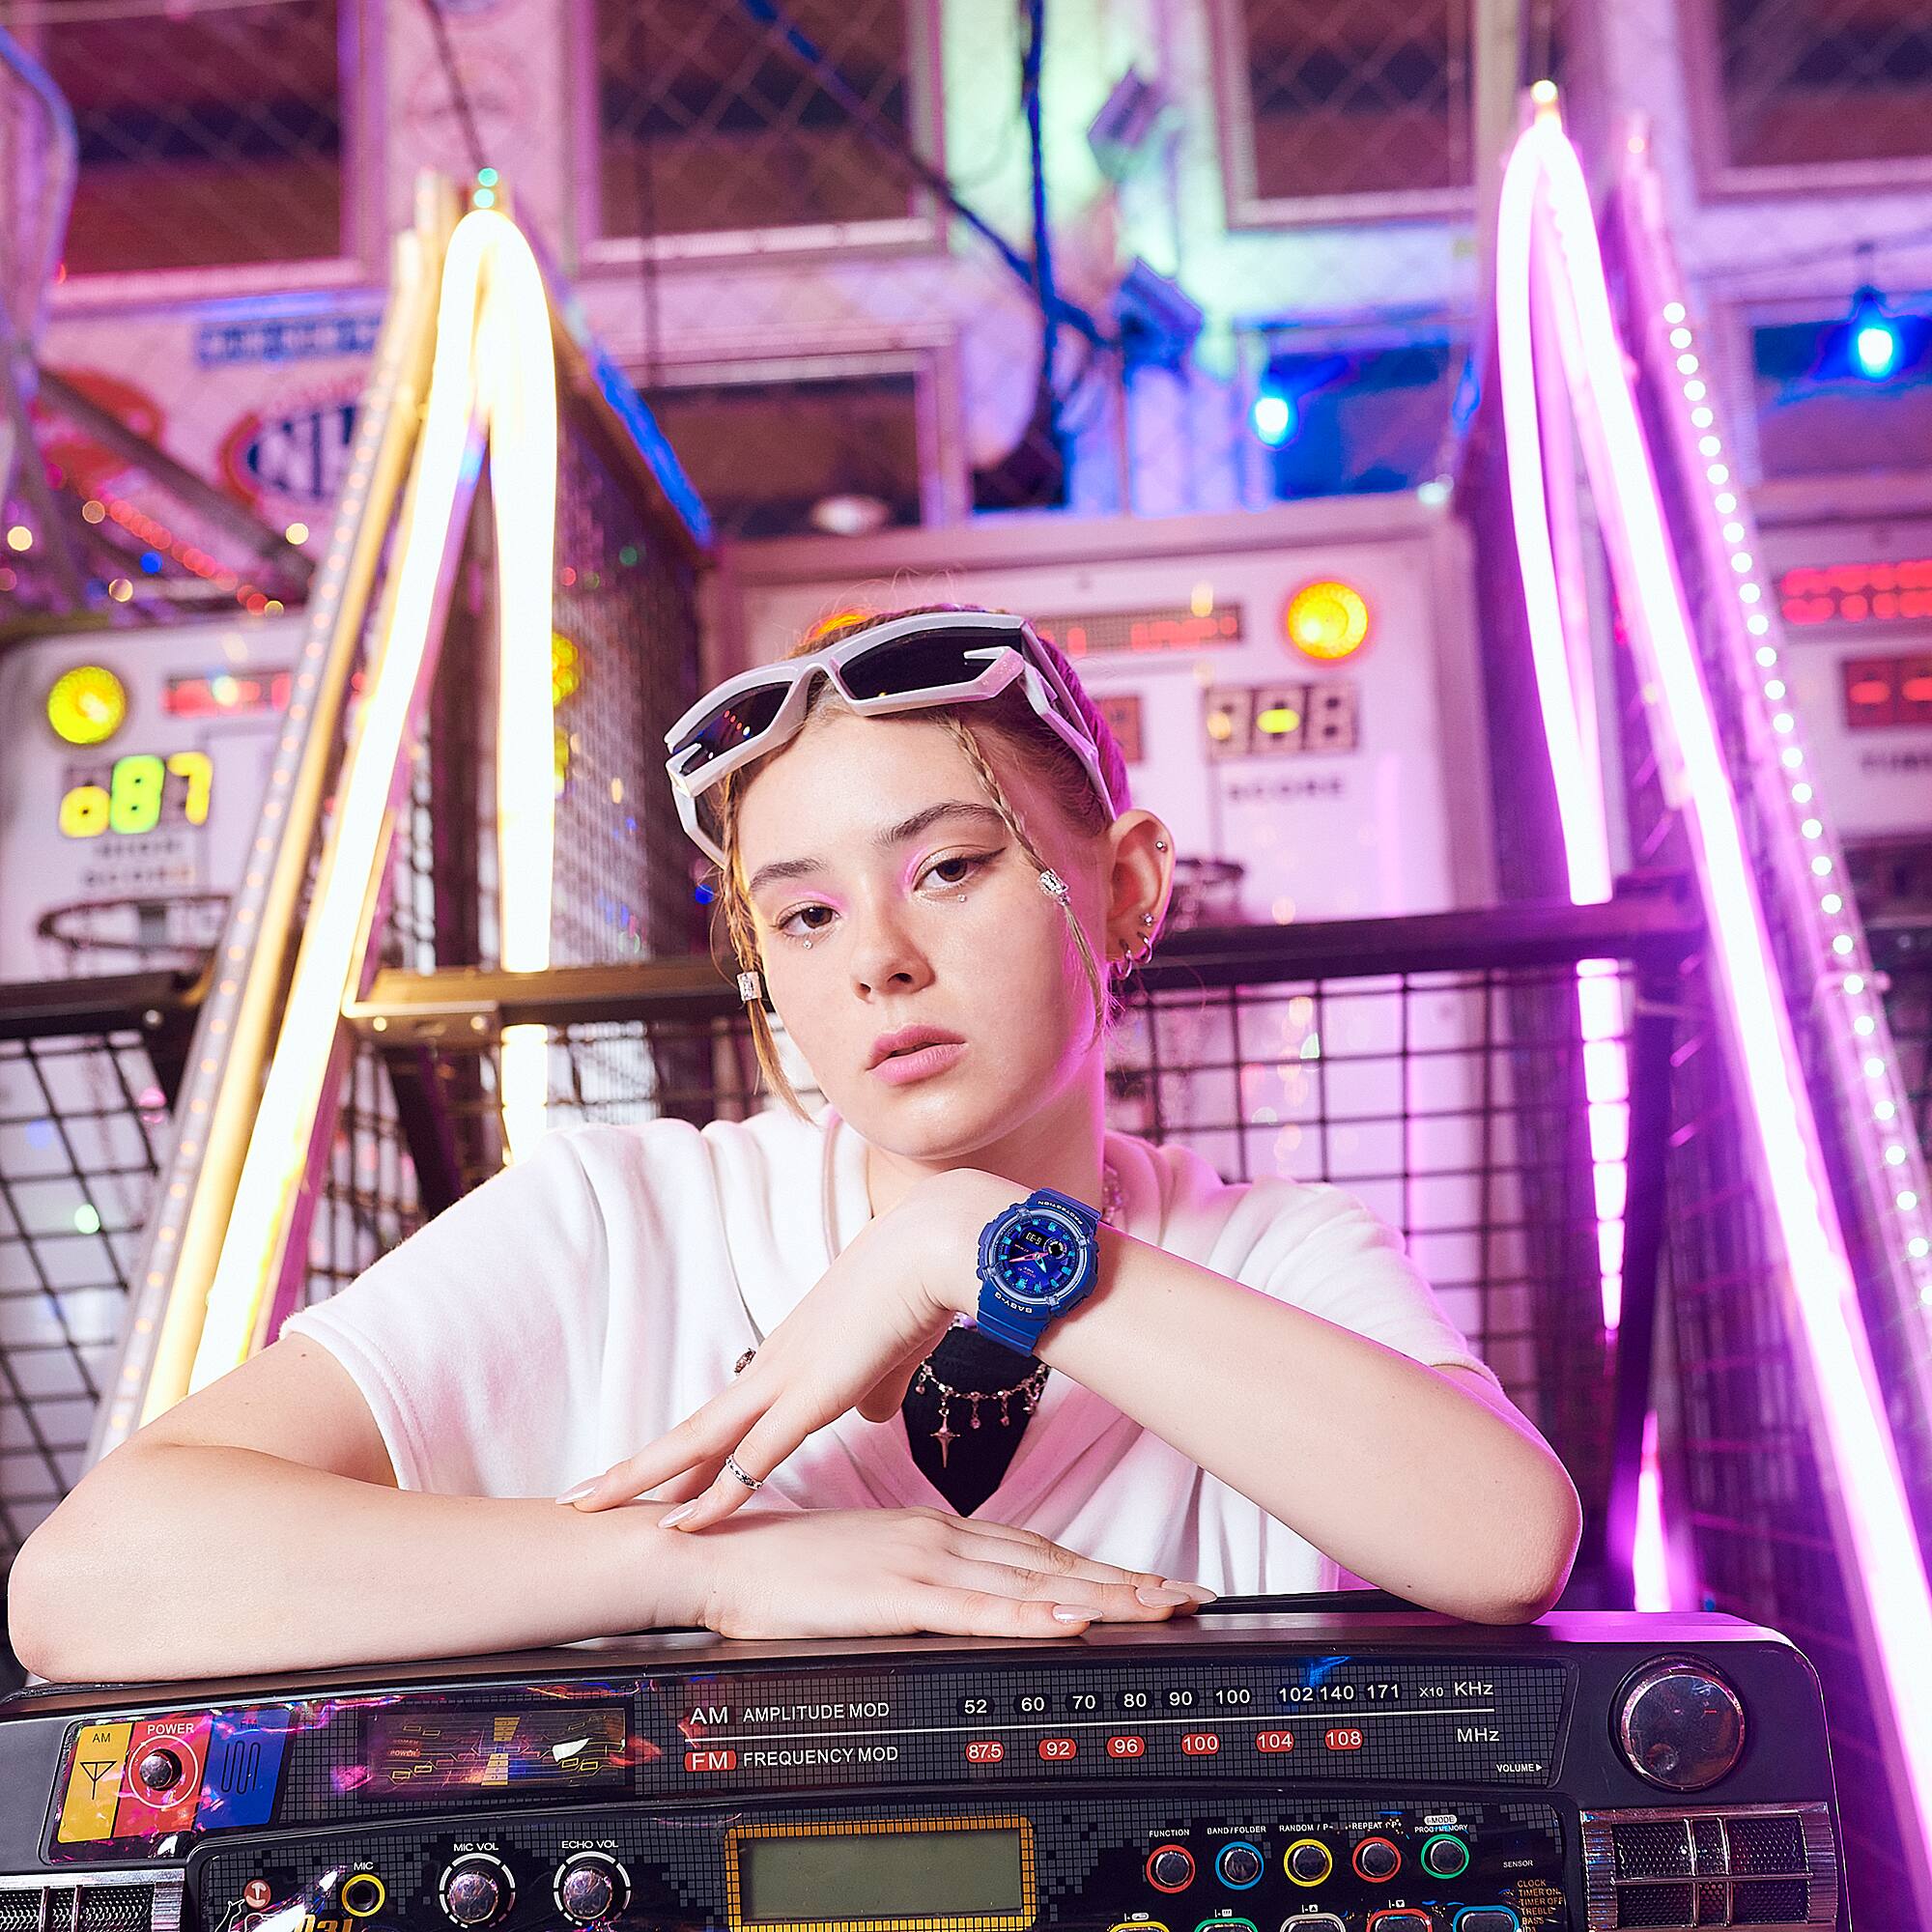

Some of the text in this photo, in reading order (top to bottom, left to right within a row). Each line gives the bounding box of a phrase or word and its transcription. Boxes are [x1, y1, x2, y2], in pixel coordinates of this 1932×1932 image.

[994, 1292, 1033, 1314] BABY-G
[690, 1706, 728, 1724] AM
[743, 1703, 844, 1722] AMPLITUDE
[849, 1702, 890, 1719] MOD
[964, 1698, 987, 1714] 52
[1021, 1696, 1045, 1712] 60
[1072, 1694, 1095, 1710] 70
[1123, 1692, 1147, 1708] 80
[1169, 1690, 1193, 1706] 90
[1215, 1689, 1250, 1704] 100
[1279, 1687, 1314, 1702] 102
[1320, 1685, 1354, 1700] 140
[1367, 1684, 1399, 1699] 171
[1454, 1681, 1493, 1696] KHz
[147, 1722, 194, 1735] POWER
[92, 1732, 111, 1743] AM
[692, 1727, 1499, 1770] FM FREQUENCY MOD 87.5 92 96 100 104 108 MHz
[1496, 1763, 1535, 1773] VOLUME
[1279, 1823, 1314, 1833] RANDOM
[1352, 1821, 1382, 1831] REPEAT
[1149, 1829, 1190, 1838] FUNCTION
[453, 1842, 499, 1852] MIC VOL
[561, 1839, 619, 1849] ECHO VOL
[354, 1861, 374, 1871] MIC
[1503, 1860, 1533, 1868] SENSOR
[1517, 1879, 1547, 1889] CLOCK
[1519, 1889, 1545, 1897] TIMER
[1547, 1896, 1564, 1905] OFF
[1521, 1907, 1553, 1916] TREBLE
[1521, 1917, 1545, 1925] BASS
